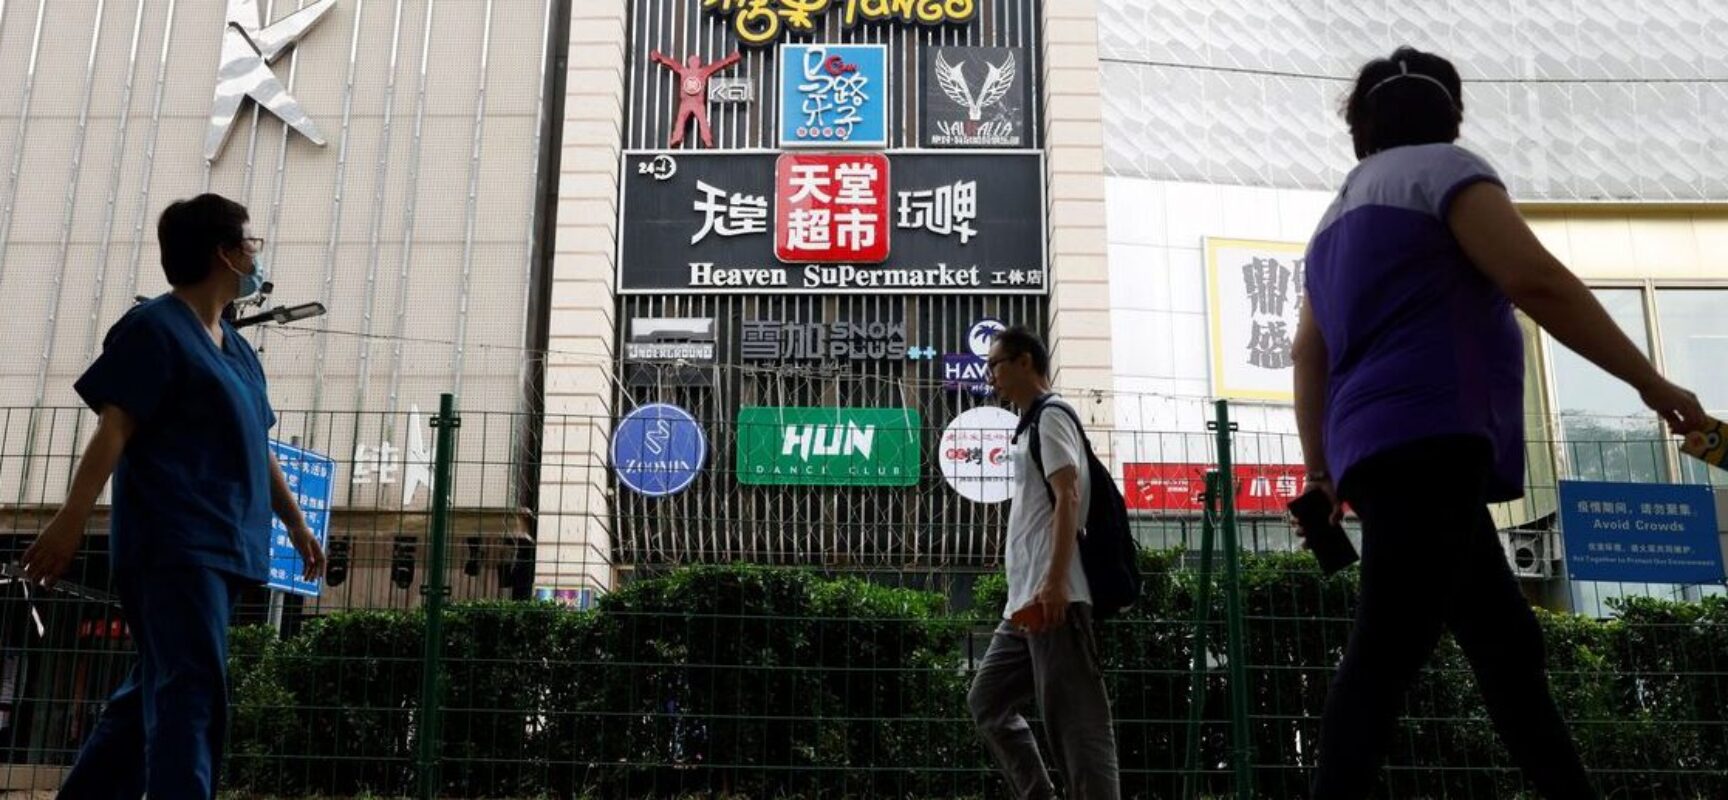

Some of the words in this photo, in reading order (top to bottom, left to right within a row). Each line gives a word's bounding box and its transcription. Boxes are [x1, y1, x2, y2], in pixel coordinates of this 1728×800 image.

[639, 162, 654, 173] 24
[789, 163, 877, 204] 天堂
[691, 180, 768, 245] 天堂
[897, 180, 978, 244] 玩啤
[787, 208, 877, 251] 超市
[689, 263, 787, 286] Heaven
[991, 269, 1042, 285] 工体店
[831, 322, 905, 339] SNOW
[743, 321, 824, 359] 雪加
[629, 343, 713, 358] UNDERGROUND
[831, 341, 905, 359] PLUS
[945, 362, 992, 379] HAV
[781, 419, 875, 462] HUN
[849, 466, 900, 475] CLUB
[1593, 519, 1630, 530] Avoid
[1635, 520, 1685, 531] Crowds
